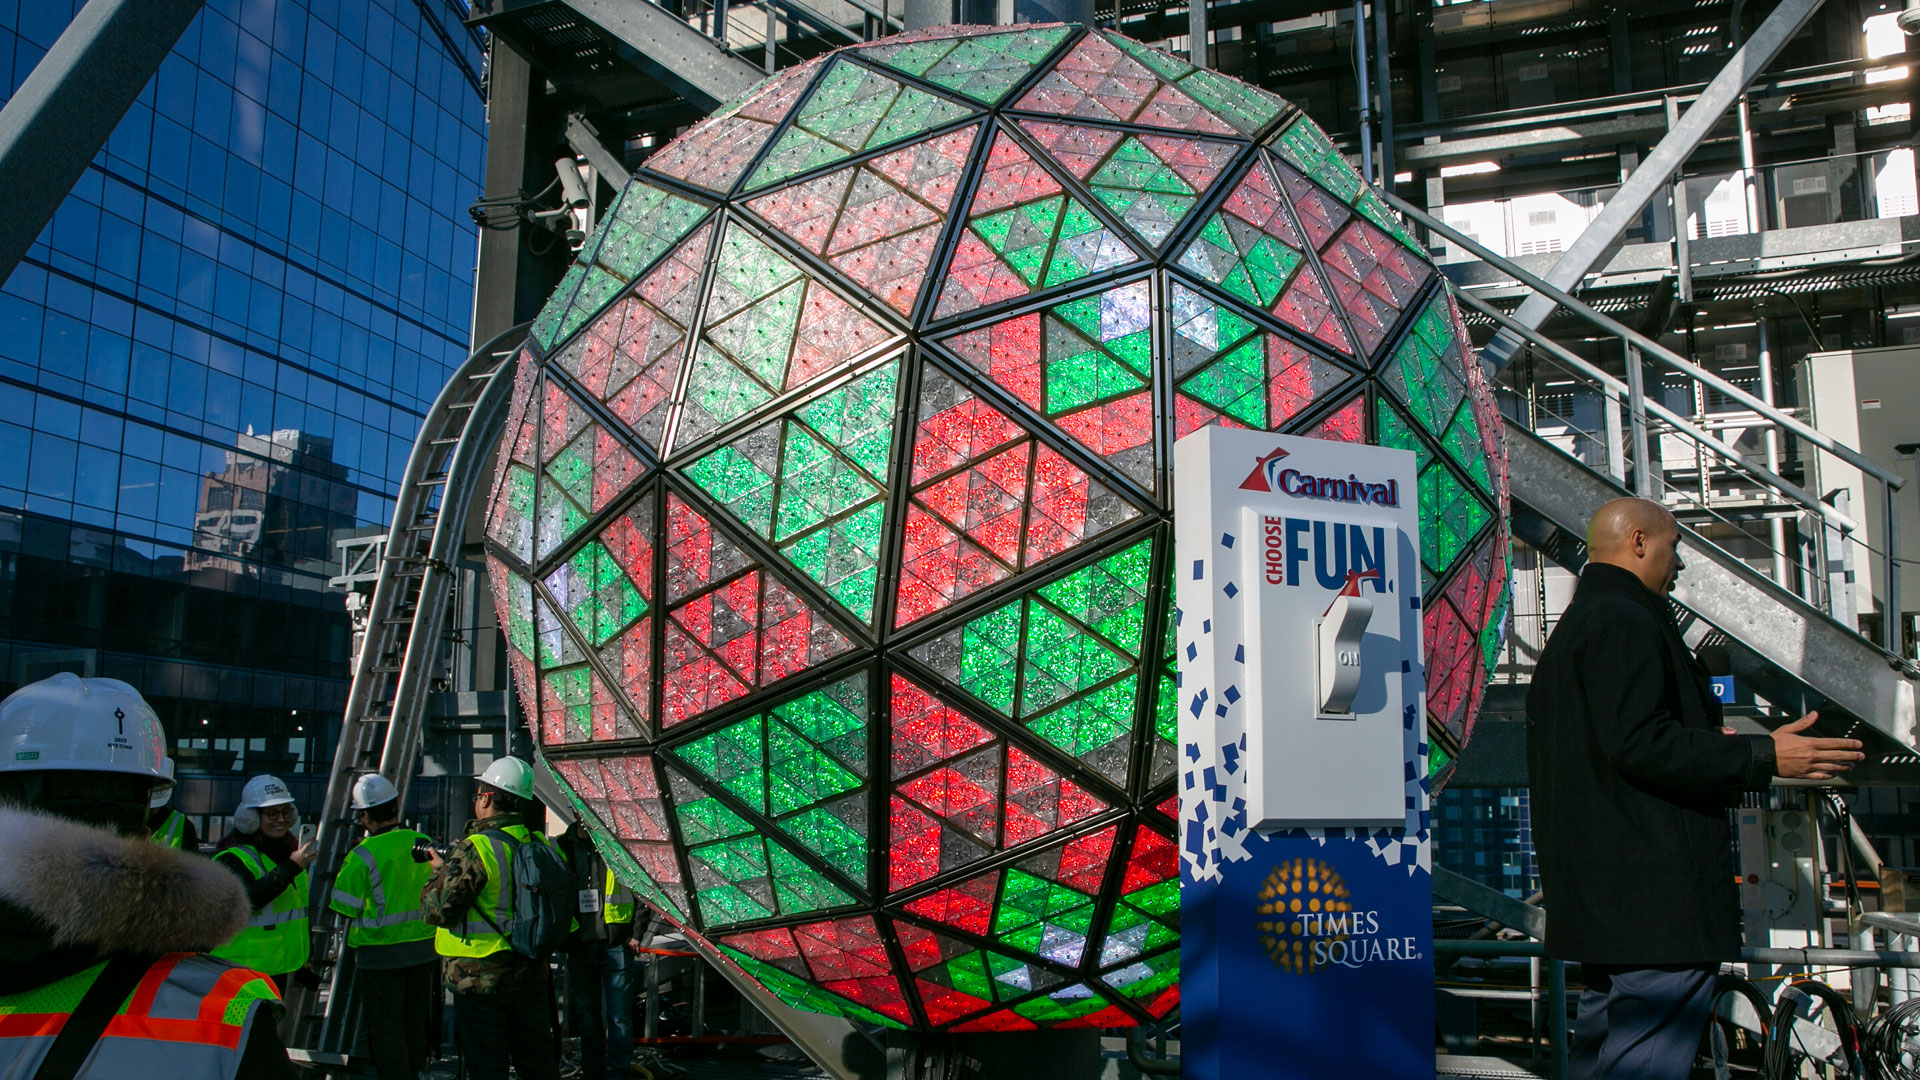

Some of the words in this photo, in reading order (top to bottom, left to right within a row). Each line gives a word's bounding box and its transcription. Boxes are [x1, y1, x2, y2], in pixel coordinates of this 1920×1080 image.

[1278, 468, 1398, 505] Carnival
[1265, 515, 1283, 585] CHOOSE
[1338, 650, 1361, 666] ON
[1297, 910, 1379, 936] TIMES
